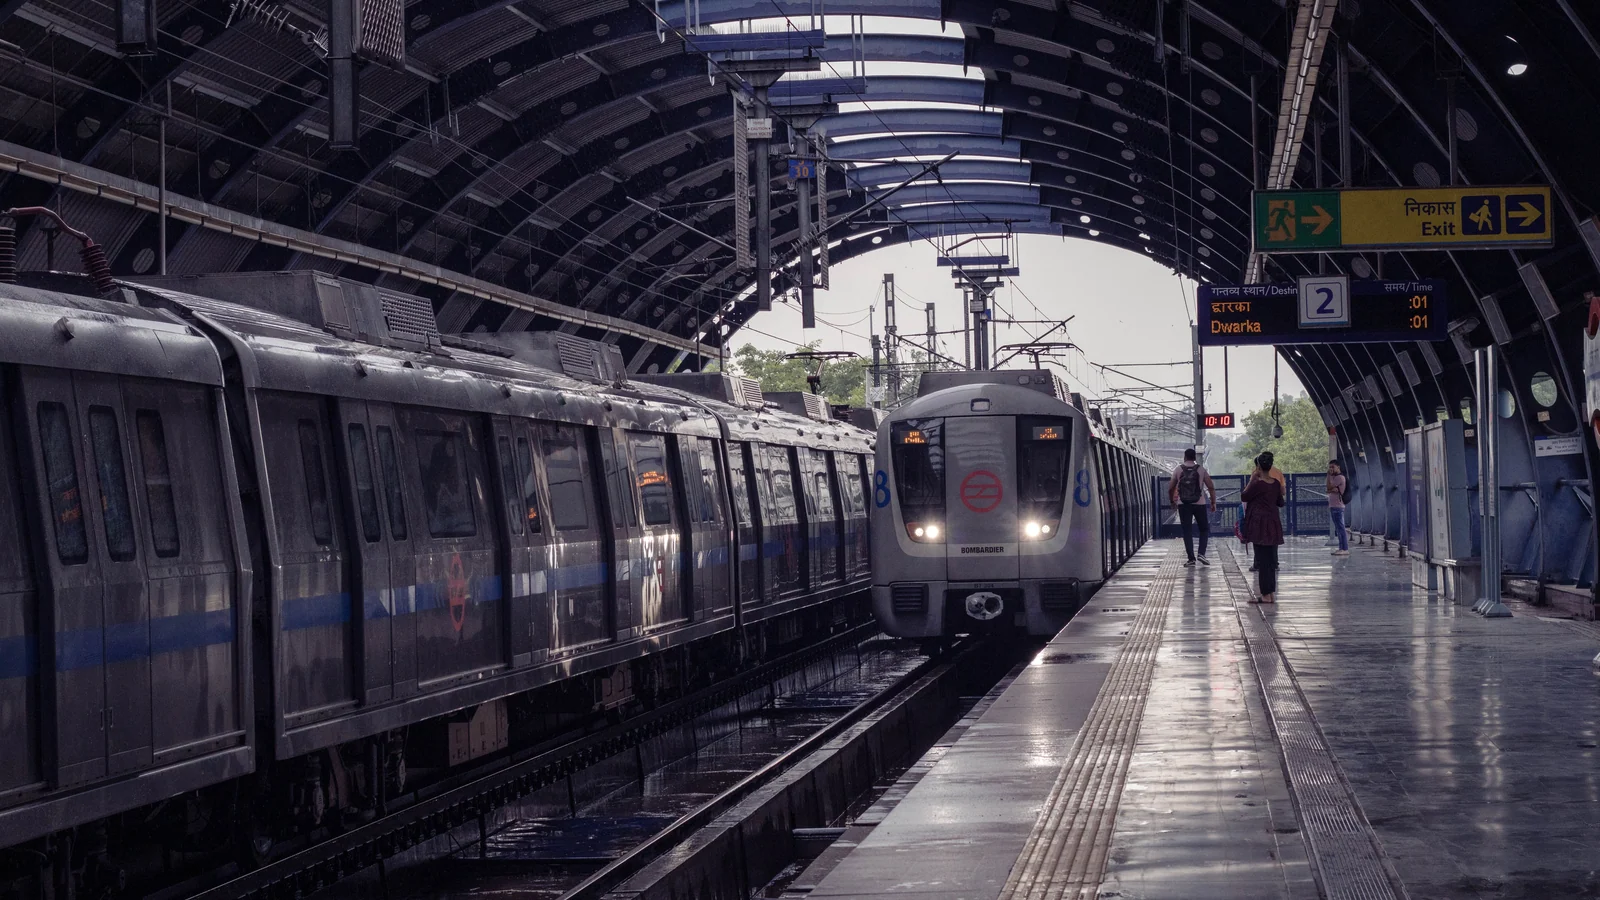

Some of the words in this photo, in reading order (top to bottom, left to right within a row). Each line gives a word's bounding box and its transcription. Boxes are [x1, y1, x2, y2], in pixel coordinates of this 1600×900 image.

[1403, 197, 1456, 216] निकास
[1422, 221, 1456, 236] Exit
[1211, 286, 1240, 296] गन्तव्य
[1211, 301, 1251, 313] द्वारका
[1315, 287, 1335, 315] 2
[1409, 295, 1427, 309] :01
[1211, 319, 1262, 333] Dwarka
[1409, 314, 1428, 329] :01
[1205, 416, 1230, 427] 10:10
[875, 470, 891, 509] 8
[1073, 469, 1091, 508] 8
[961, 546, 1004, 555] BOMBARDIER
